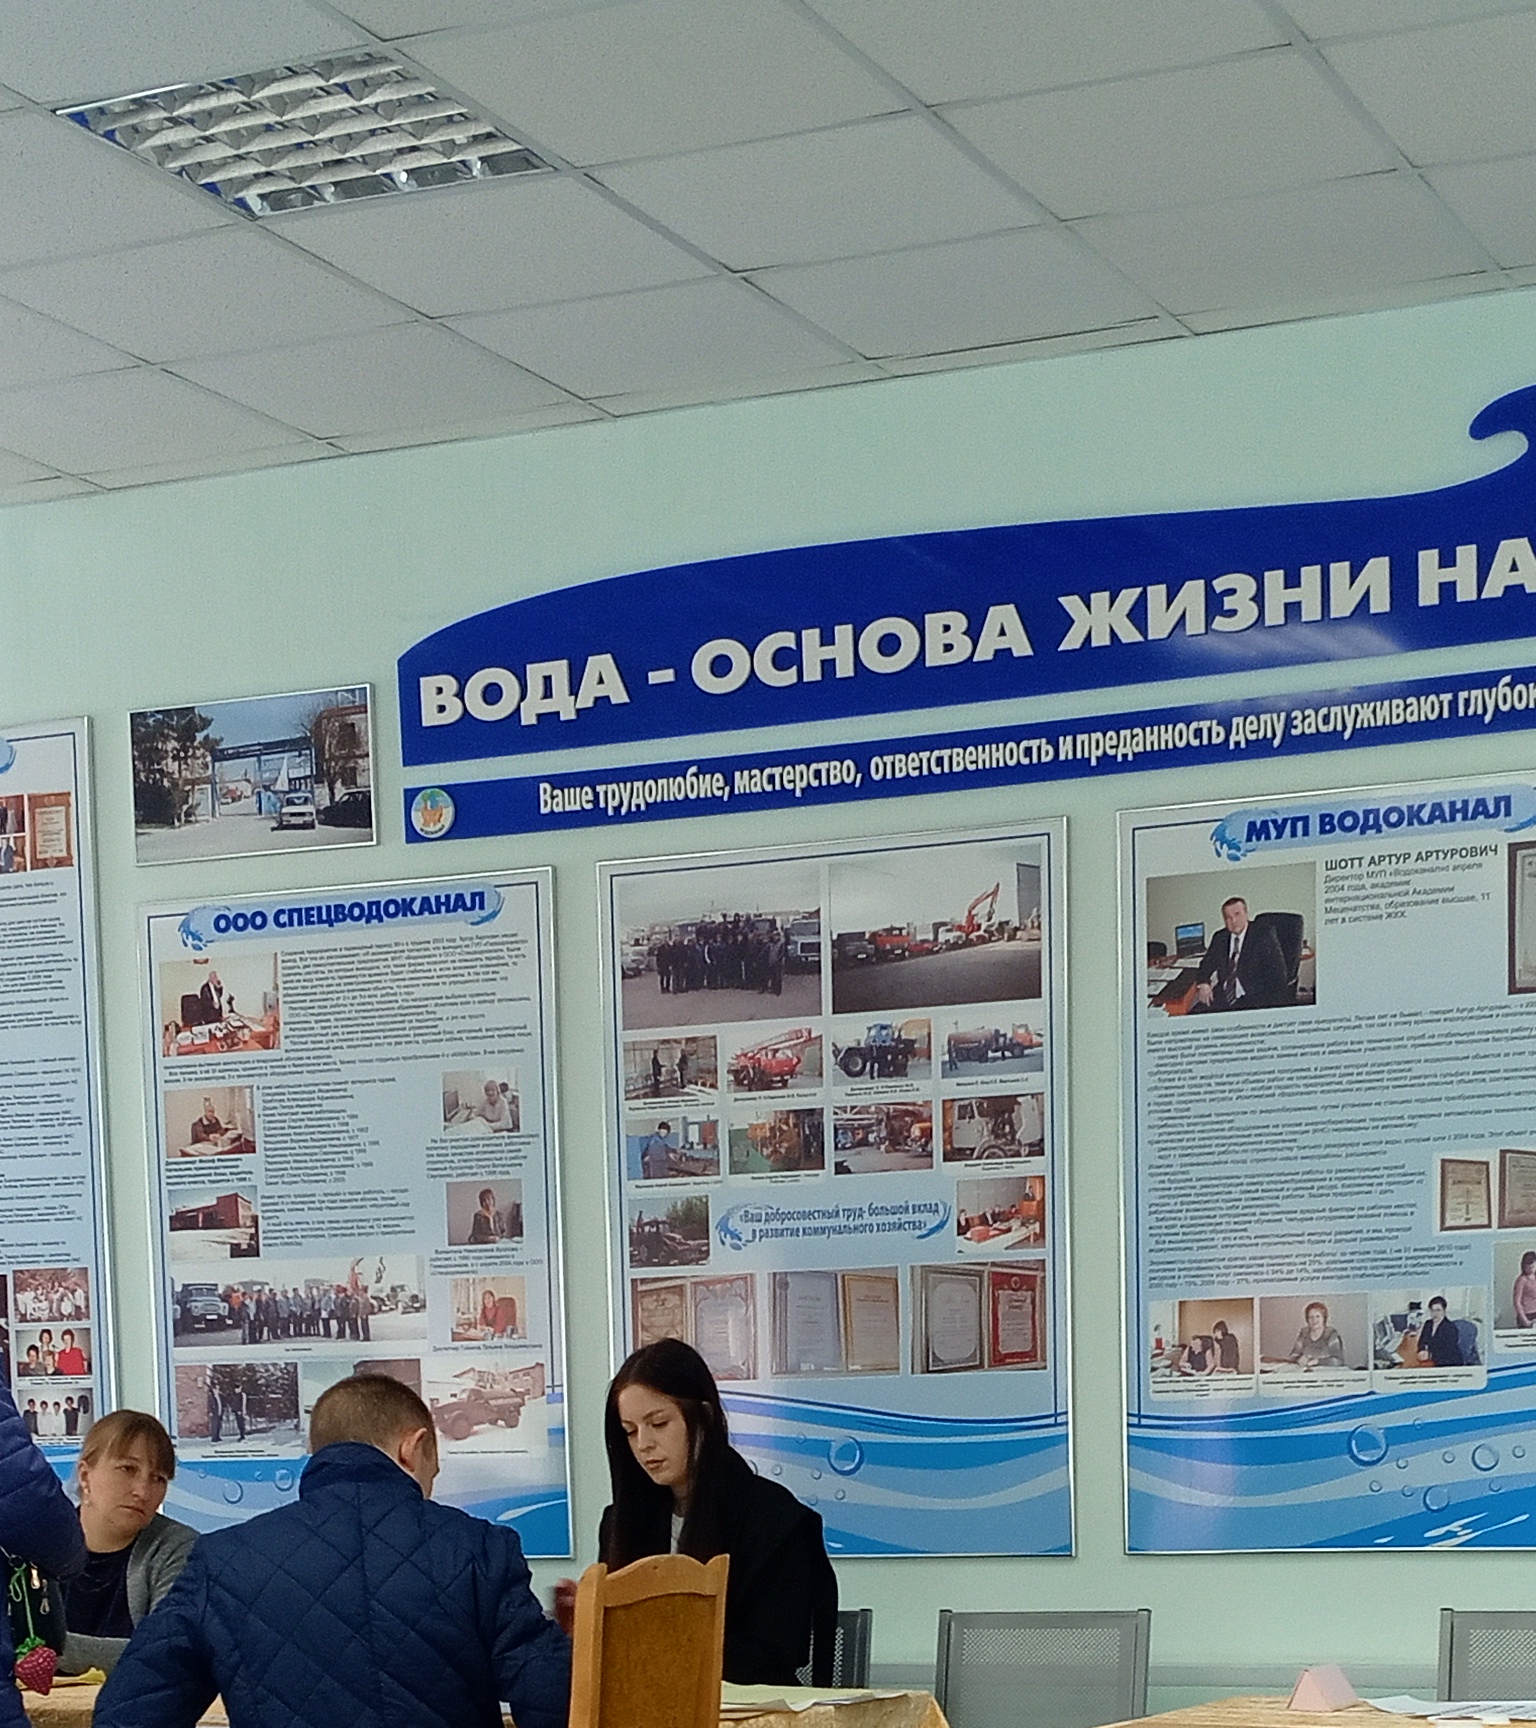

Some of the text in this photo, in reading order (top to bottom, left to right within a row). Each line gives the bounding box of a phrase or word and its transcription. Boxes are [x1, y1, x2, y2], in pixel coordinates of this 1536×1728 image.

[419, 652, 630, 727] ВОДА
[690, 603, 1033, 694] ОСНОВА
[1058, 556, 1391, 651] ЖИЗНИ
[539, 781, 594, 815] Ваше
[596, 767, 730, 815] трудолюбие,
[734, 756, 862, 797] мастерство,
[870, 737, 1054, 780] ответственность
[1059, 733, 1073, 760] и
[1075, 724, 1226, 766] преданность
[1229, 711, 1287, 750] делу
[1291, 692, 1453, 741] заслуживают
[1245, 794, 1512, 843] МУП ВОДОКАНАЛ
[1325, 844, 1499, 871] ШОТТ АРТУР АРТУРОВИЧ
[213, 890, 486, 934] ООО СПЕЦВОДОКАНАЛ
[758, 1225, 801, 1242] развитие
[802, 1222, 874, 1239] коммунального
[764, 1205, 841, 1225] добросовестный
[867, 1201, 910, 1217] большой
[911, 1202, 939, 1216] вклад
